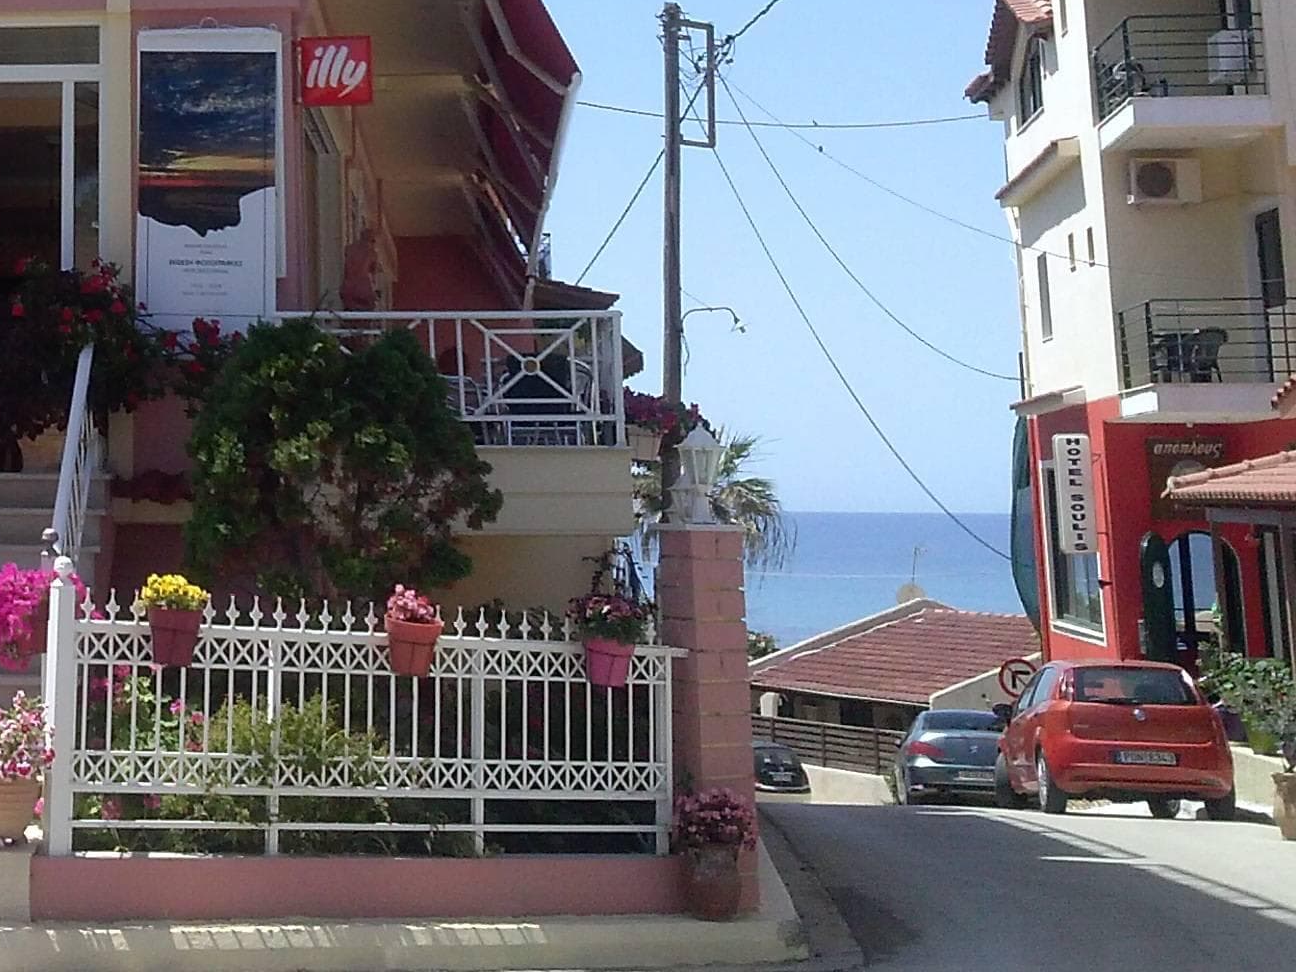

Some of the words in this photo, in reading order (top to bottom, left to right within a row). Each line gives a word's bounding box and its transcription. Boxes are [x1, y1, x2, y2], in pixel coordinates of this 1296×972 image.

[306, 45, 367, 98] illy
[1066, 438, 1083, 487] HOTEL
[1071, 494, 1088, 551] SOULIS
